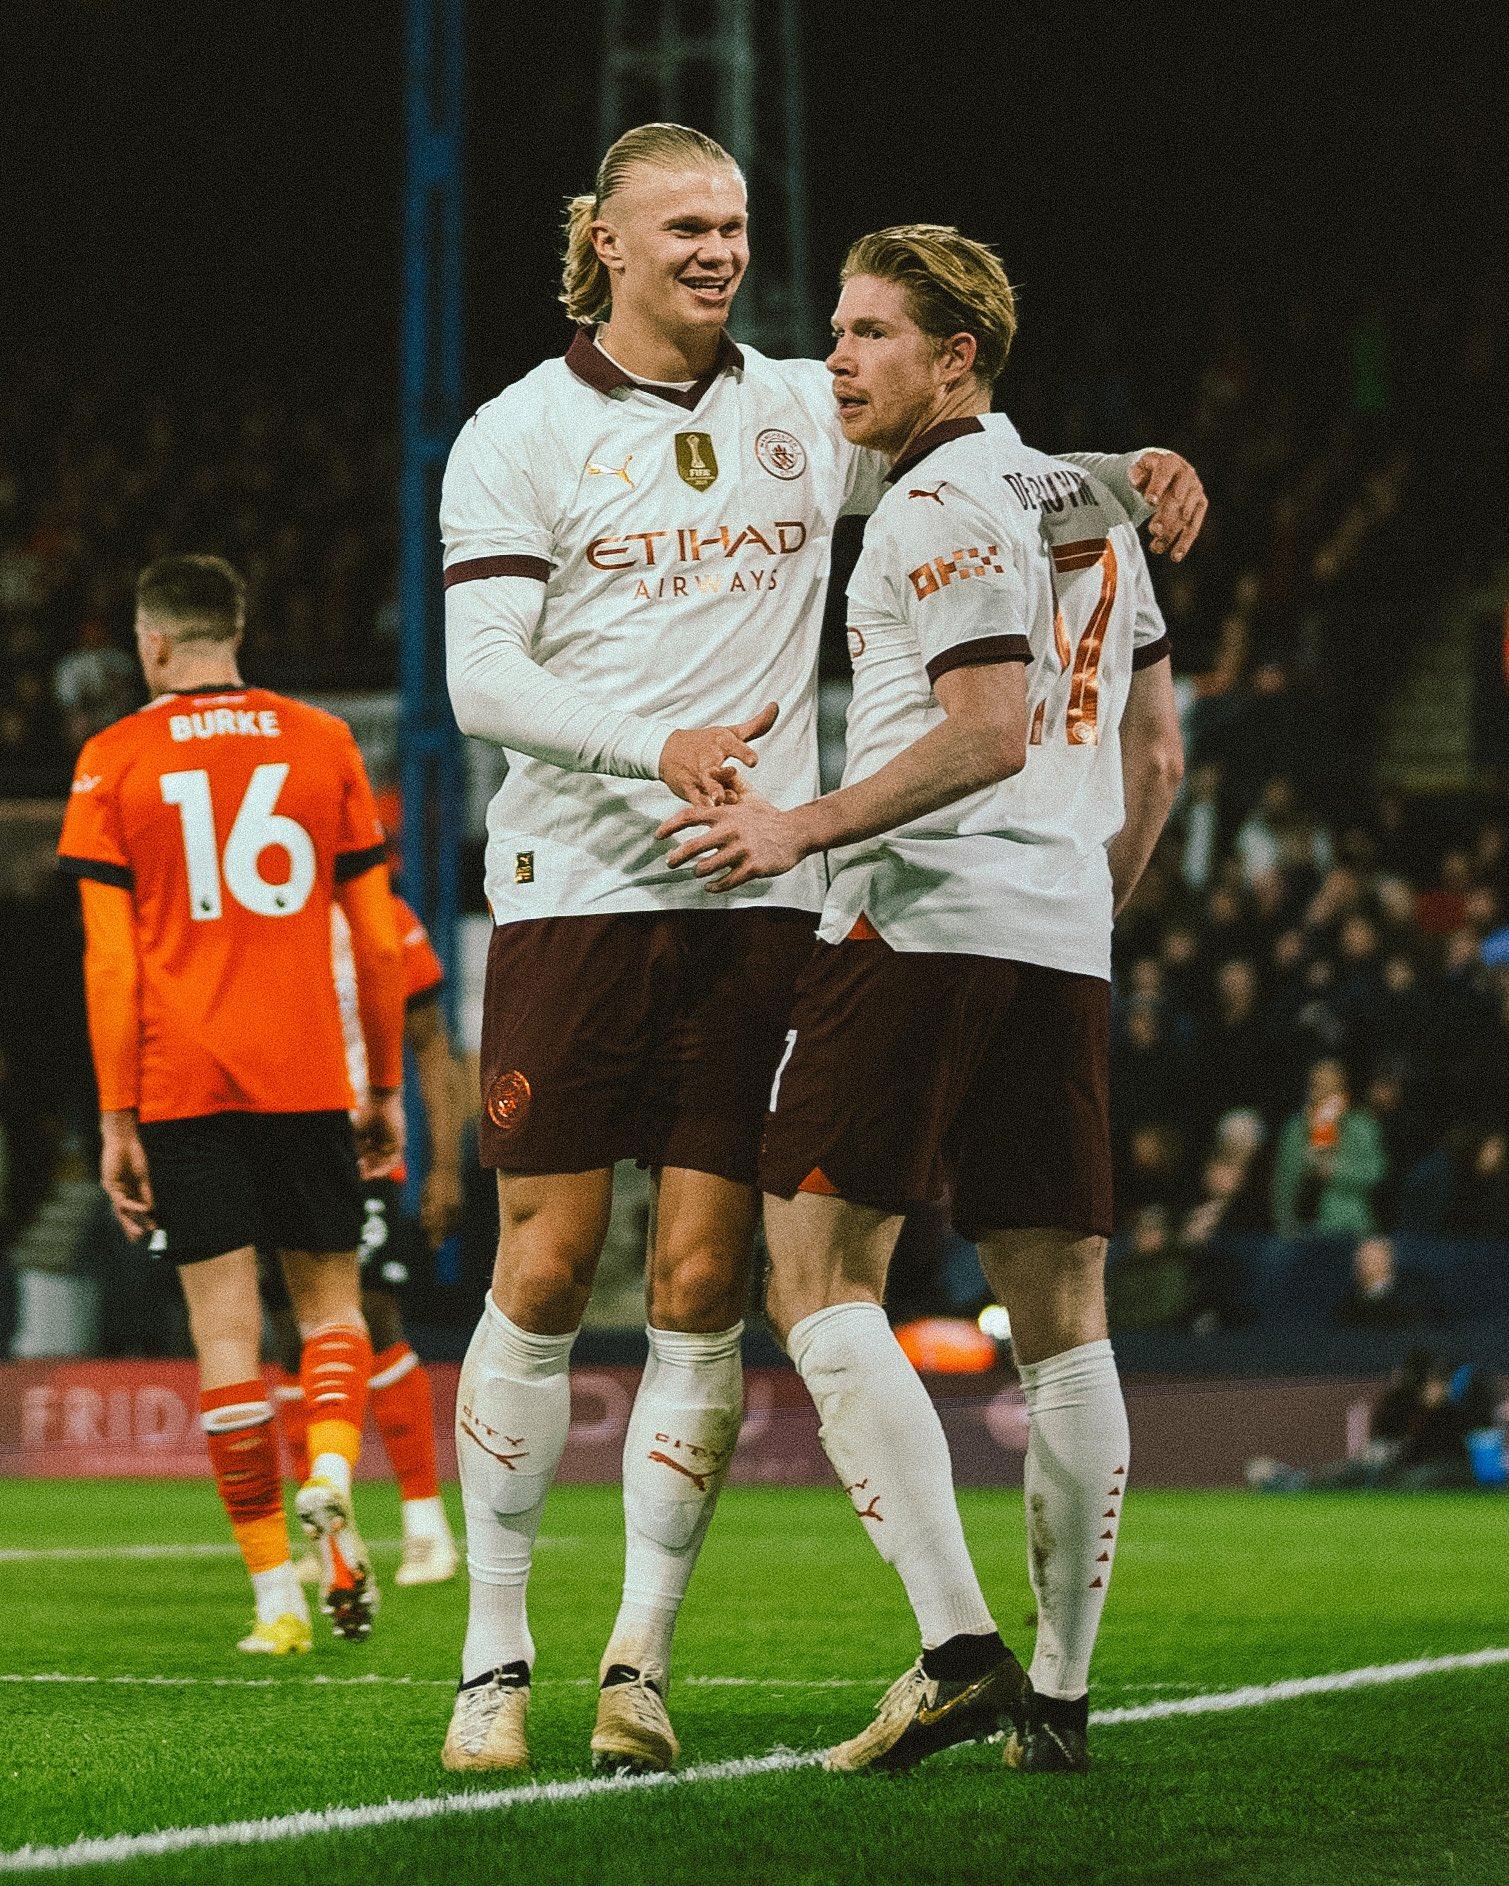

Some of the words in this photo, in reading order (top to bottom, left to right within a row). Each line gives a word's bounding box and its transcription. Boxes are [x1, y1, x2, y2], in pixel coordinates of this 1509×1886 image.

[586, 521, 807, 571] ETIHAD
[634, 568, 778, 600] AIRWAYS
[169, 708, 281, 742] BURKE
[160, 762, 316, 921] 16
[21, 1385, 203, 1446] FRID
